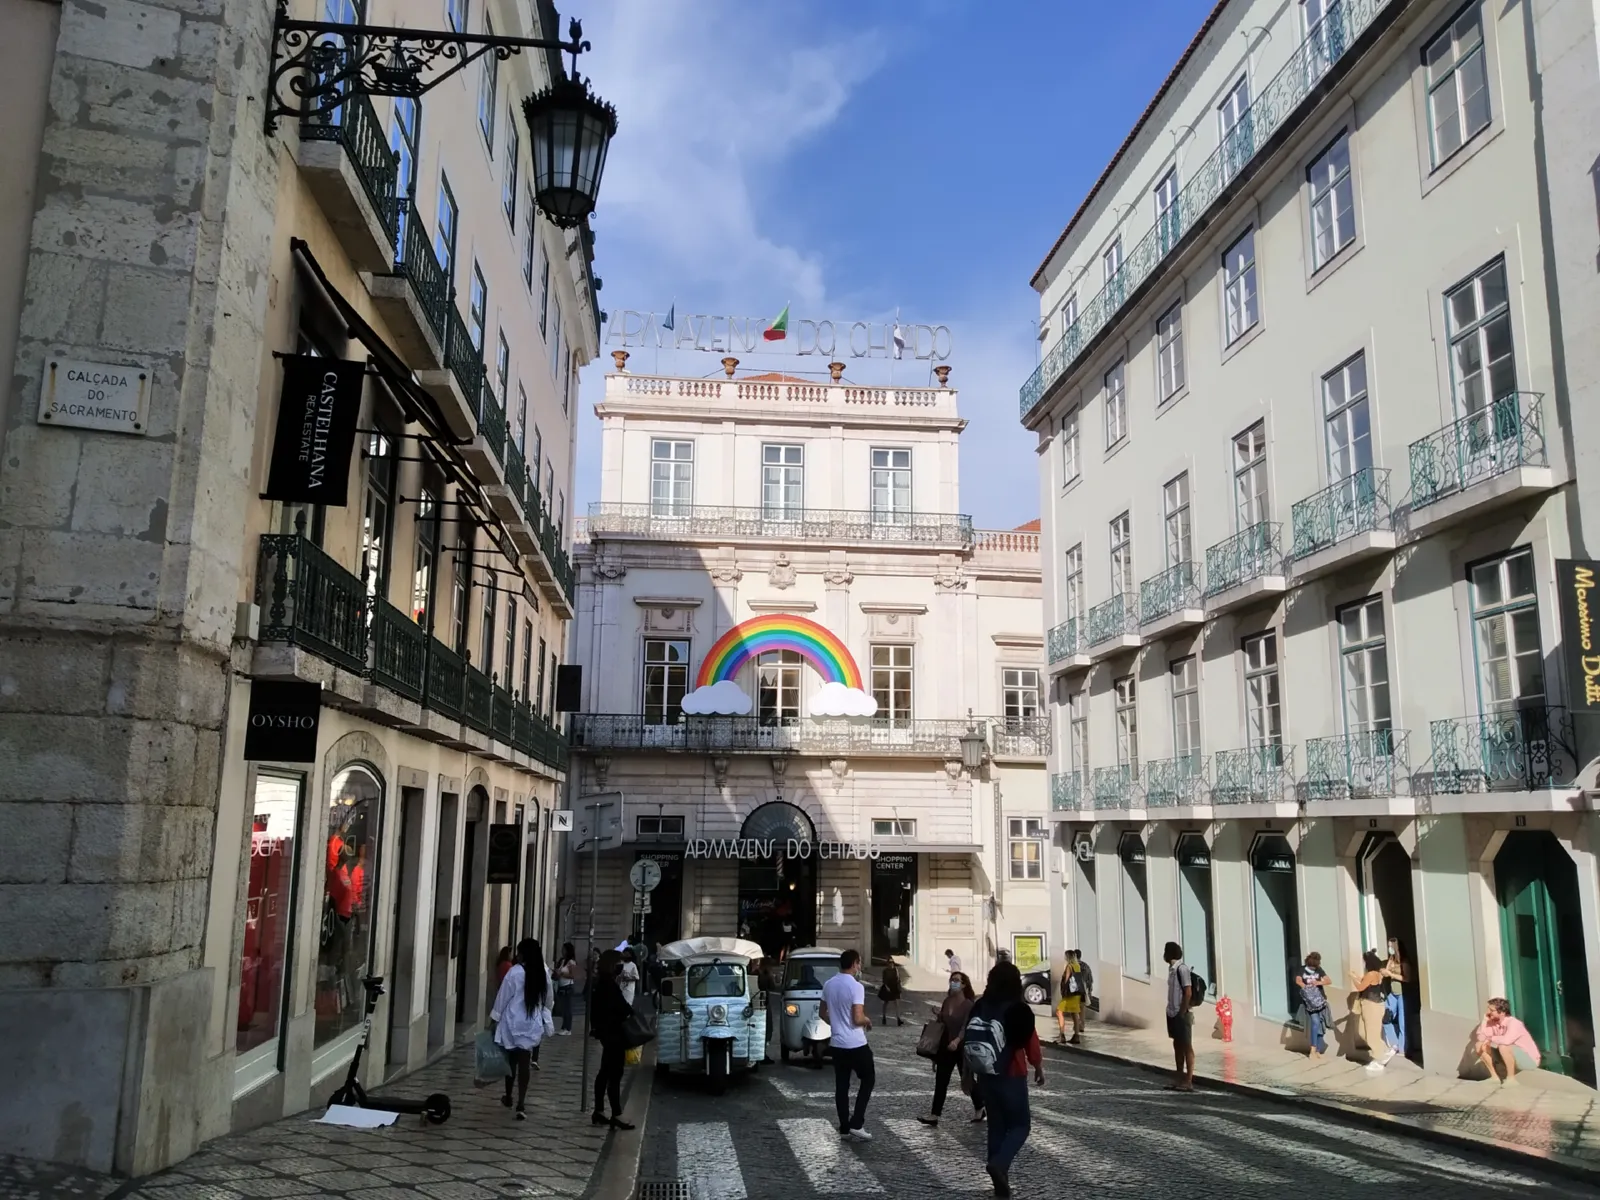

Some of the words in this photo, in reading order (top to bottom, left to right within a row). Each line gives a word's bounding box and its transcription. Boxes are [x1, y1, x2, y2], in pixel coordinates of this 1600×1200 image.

[797, 319, 836, 356] DO
[850, 321, 952, 361] CHADO
[67, 370, 128, 387] CALÇADA
[87, 389, 105, 401] DO
[50, 402, 138, 422] SACRAMENTO
[304, 394, 317, 420] REAL
[308, 371, 338, 489] CASTELHANA
[298, 422, 313, 462] ESTATE
[1574, 566, 1595, 650] Massimo
[1581, 655, 1600, 706] Dutti
[252, 713, 315, 729] OYSHO
[684, 838, 777, 859] ARMAZENS
[787, 838, 811, 859] DO
[819, 838, 881, 860] CHIADO
[876, 855, 913, 863] SHOPPING
[1267, 858, 1292, 869] ZARA
